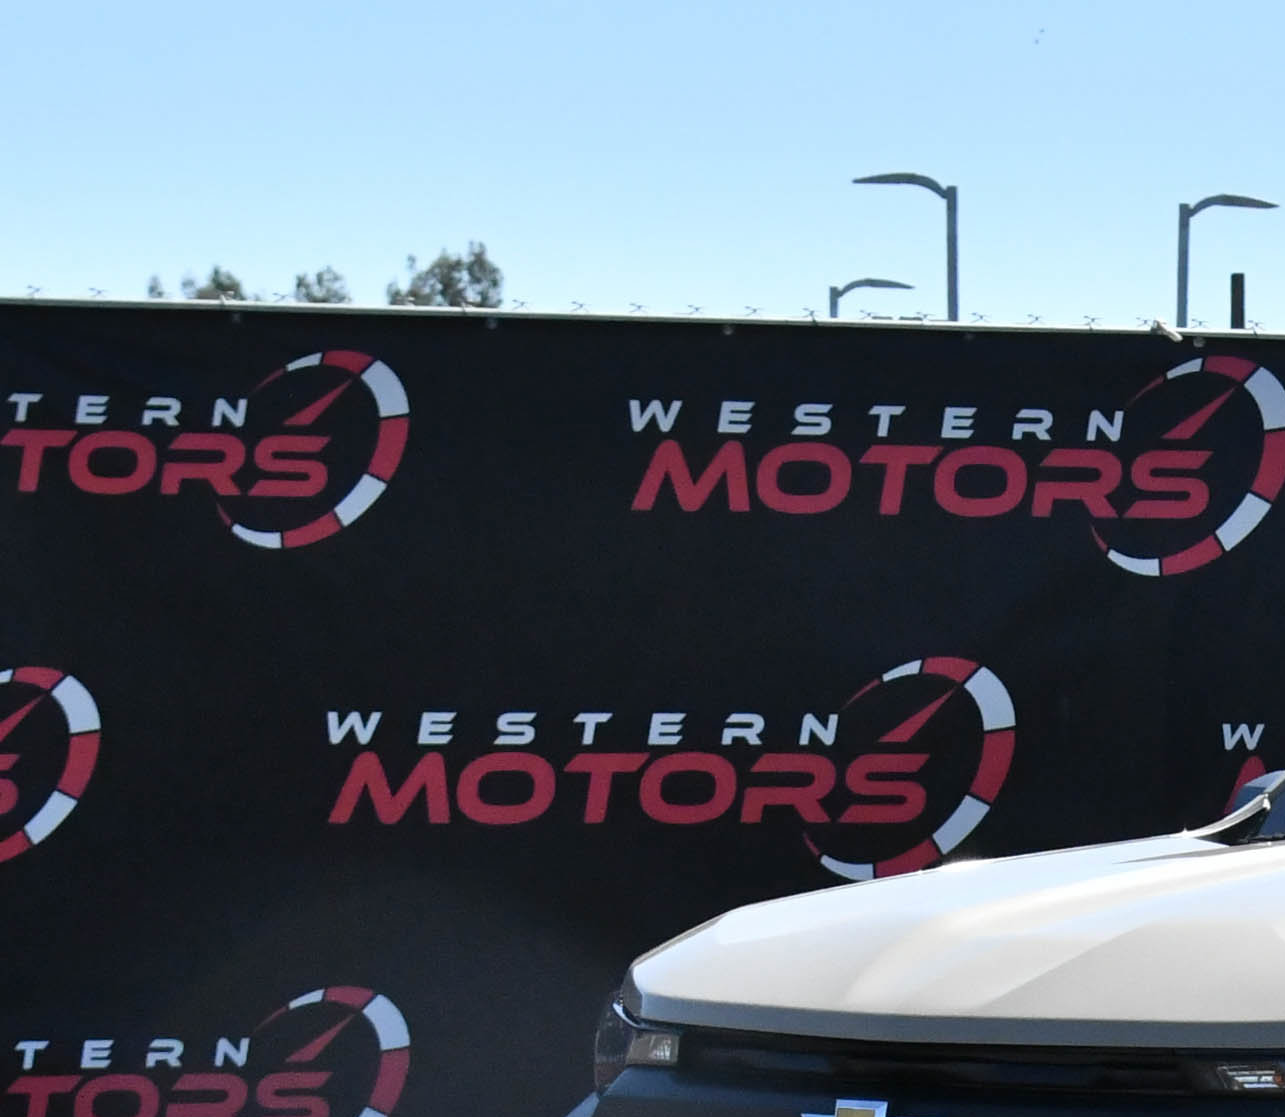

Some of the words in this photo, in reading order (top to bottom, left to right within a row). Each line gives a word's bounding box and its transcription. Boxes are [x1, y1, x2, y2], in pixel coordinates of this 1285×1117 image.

[629, 399, 1124, 442] WESTERN
[631, 439, 1213, 519] MOTORS
[327, 711, 840, 746] WESTERN
[329, 751, 931, 825] MOTORS
